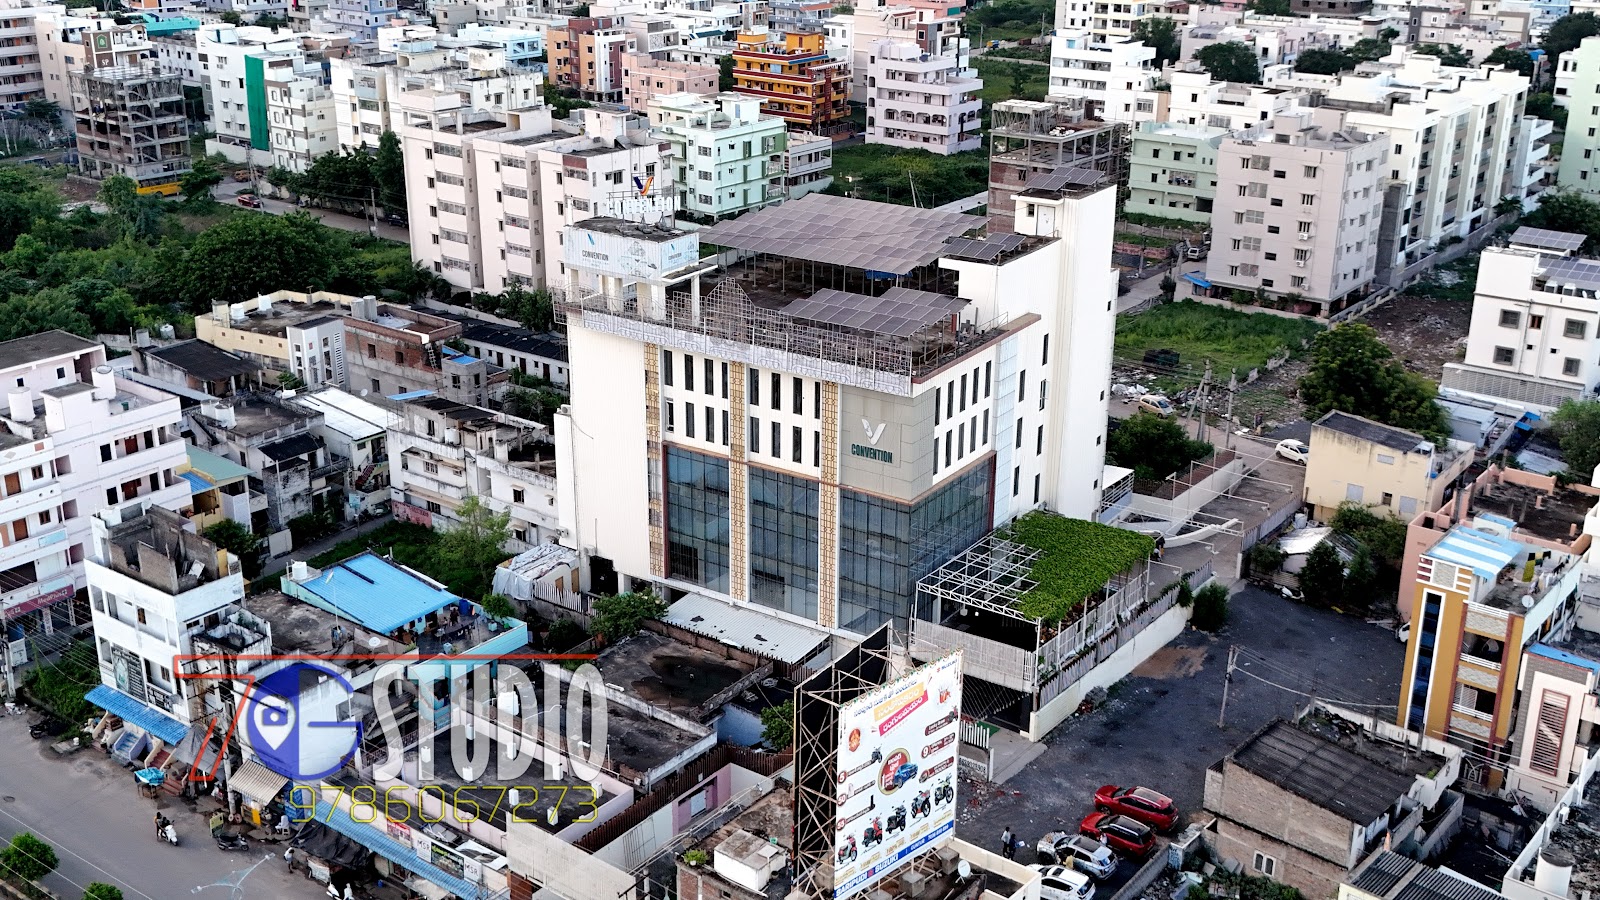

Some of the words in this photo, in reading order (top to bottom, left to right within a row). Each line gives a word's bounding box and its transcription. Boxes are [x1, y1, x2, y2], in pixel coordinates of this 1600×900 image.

[608, 196, 680, 215] CONVENTION
[582, 250, 609, 261] CONVENTION
[852, 443, 892, 463] CONVENTION
[417, 840, 430, 851] MSR
[464, 863, 478, 876] MSR
[875, 853, 898, 874] SUZUKI
